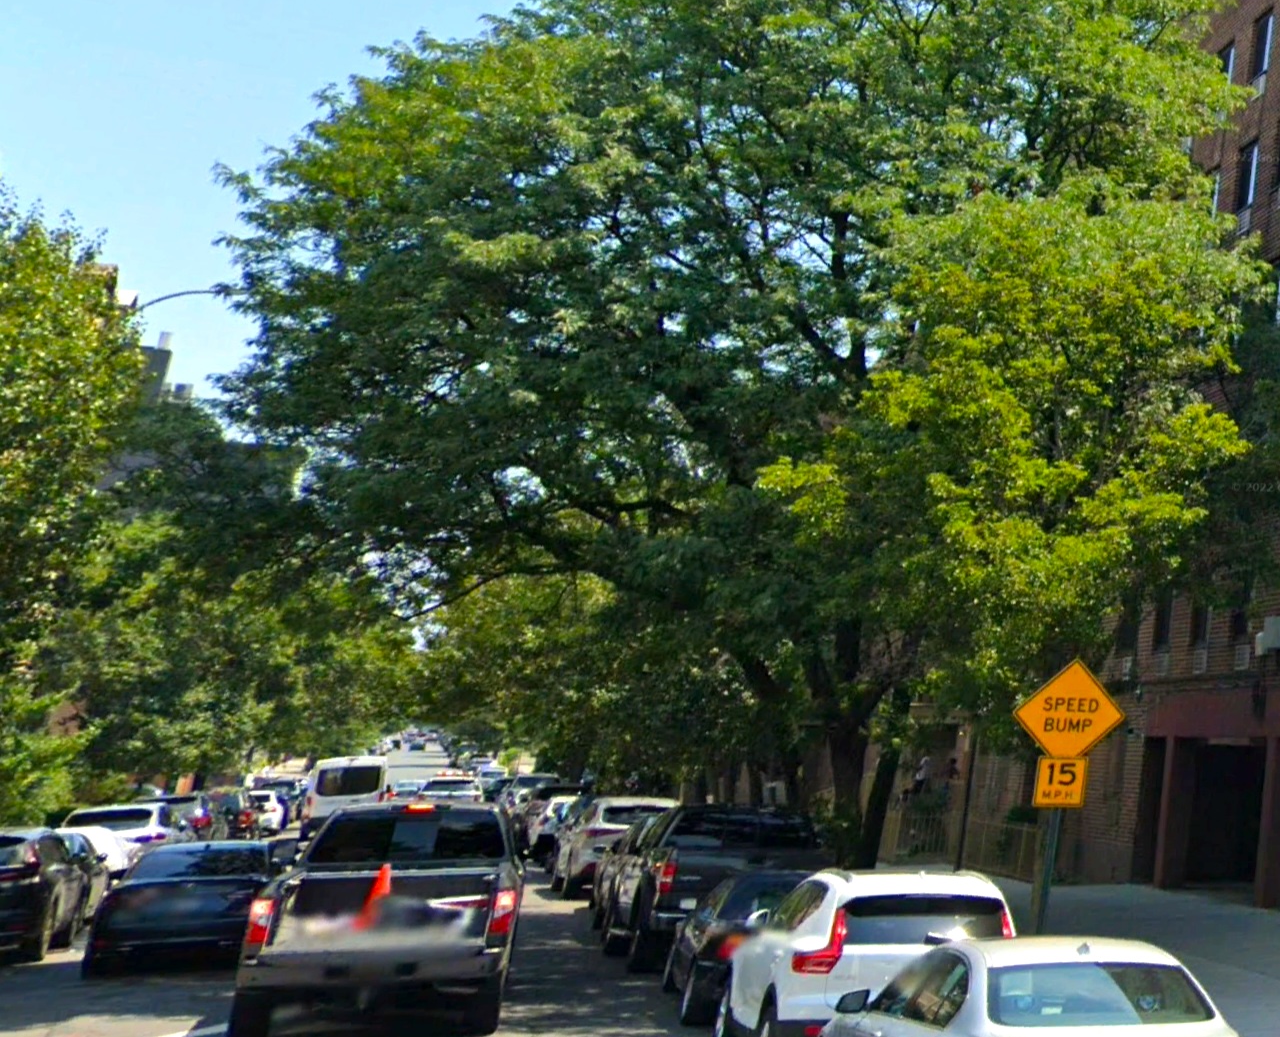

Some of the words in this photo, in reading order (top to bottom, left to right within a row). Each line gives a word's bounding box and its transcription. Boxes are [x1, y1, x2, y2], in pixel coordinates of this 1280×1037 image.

[1043, 697, 1099, 713] SPEED
[1044, 717, 1092, 733] BUMP
[1048, 763, 1076, 786] 15
